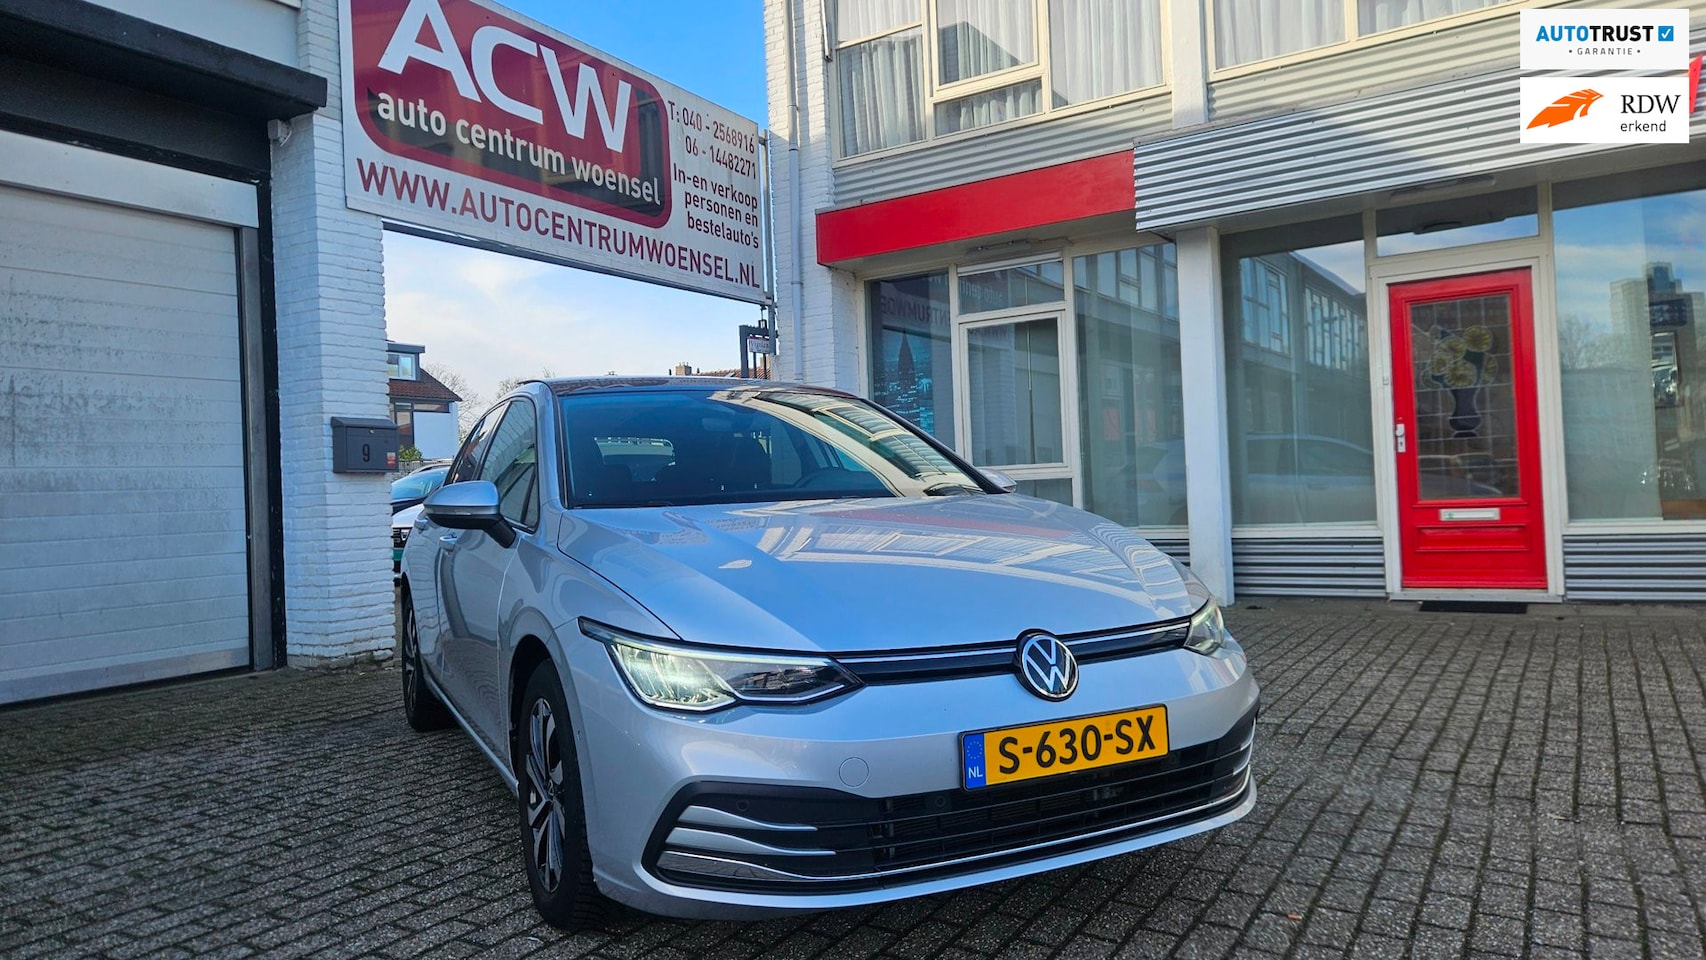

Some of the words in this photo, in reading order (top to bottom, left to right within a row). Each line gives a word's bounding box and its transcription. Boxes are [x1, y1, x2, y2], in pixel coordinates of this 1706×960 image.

[377, 0, 632, 153] ACW
[377, 91, 447, 136] auto
[456, 118, 565, 175] centrum
[571, 156, 661, 206] woensel
[682, 107, 702, 132] 040
[713, 120, 755, 154] 2568916
[685, 135, 699, 156] 06
[710, 144, 756, 180] 14482271
[673, 163, 708, 192] In-en
[710, 180, 758, 212] verkoop
[684, 191, 742, 222] personen
[745, 211, 759, 227] en
[357, 156, 760, 289] WWW.AUTOCENTRUMWOENSEL.NL
[687, 210, 759, 249] bestelauto's
[362, 444, 370, 462] 9
[998, 715, 1156, 774] S-630-SX
[968, 766, 983, 779] NL
